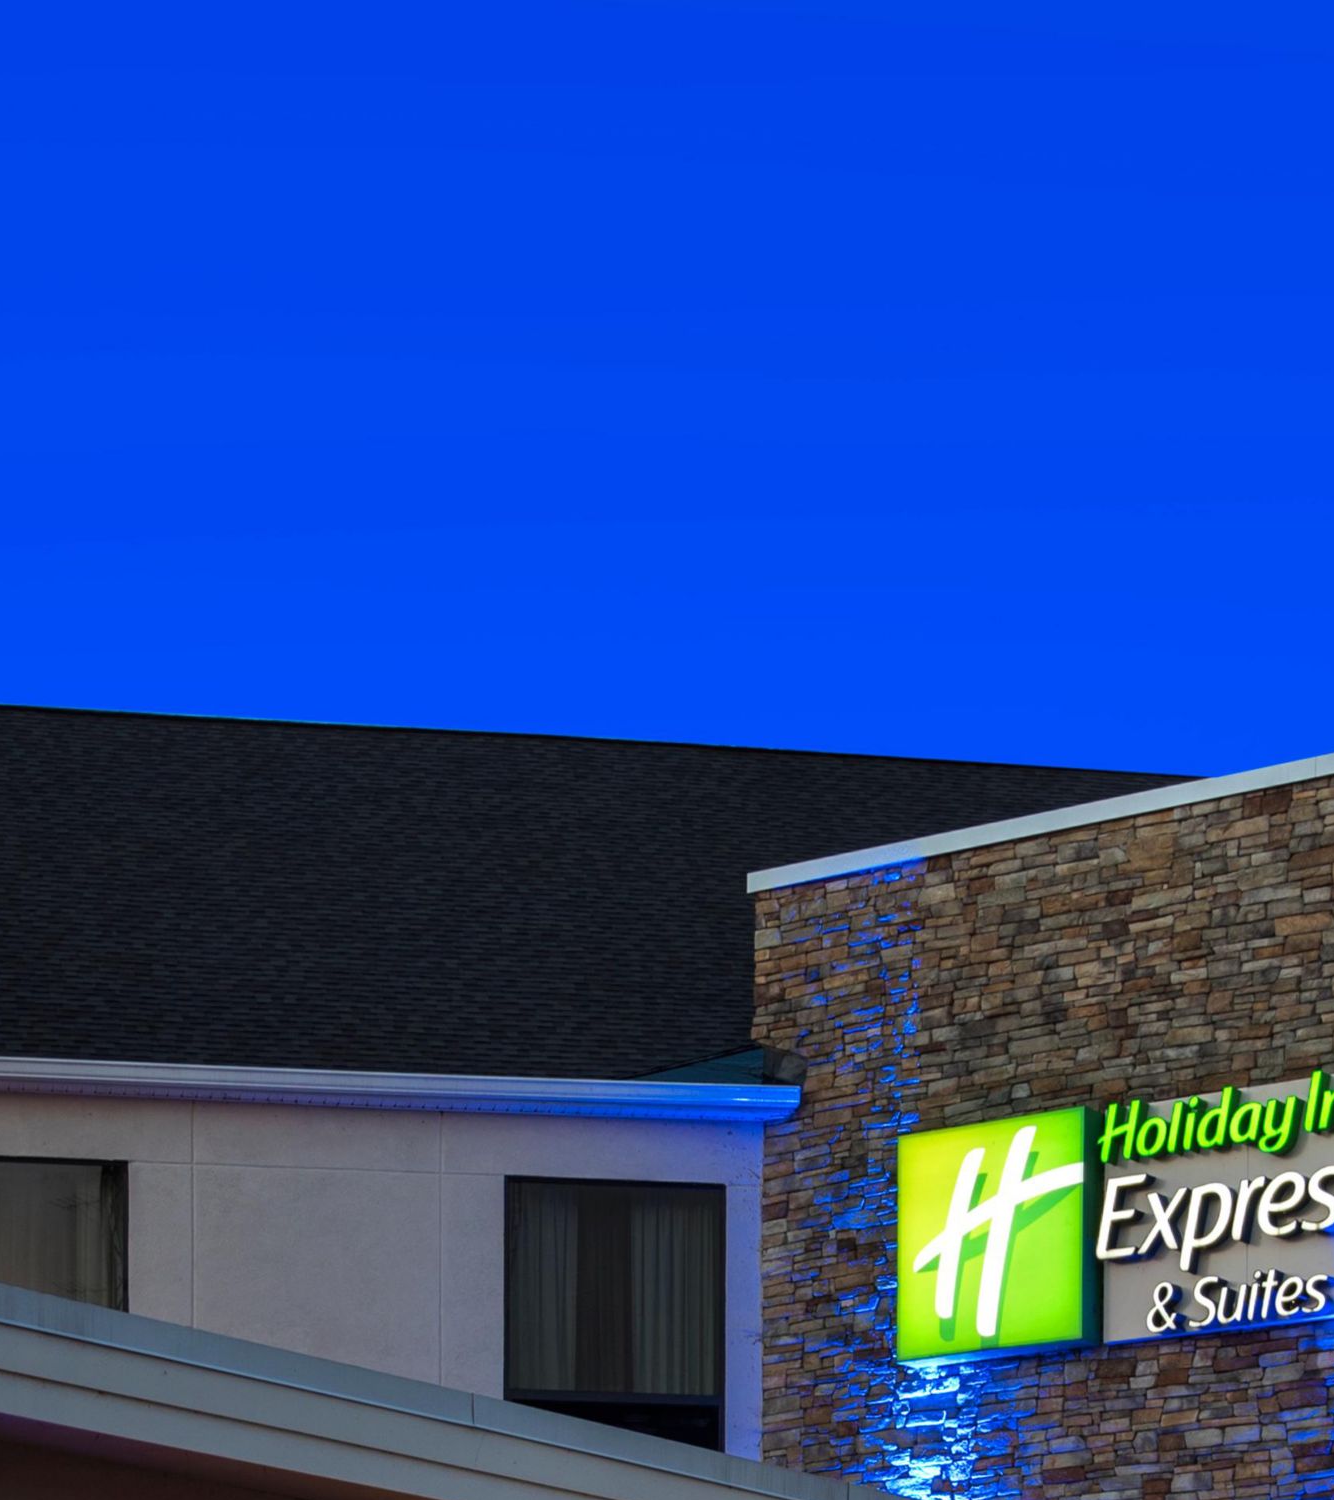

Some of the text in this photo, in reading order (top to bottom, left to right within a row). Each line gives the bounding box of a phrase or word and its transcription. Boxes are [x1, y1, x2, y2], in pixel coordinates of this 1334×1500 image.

[1098, 1086, 1298, 1164] Holiday
[1146, 1269, 1329, 1334] & Suites
